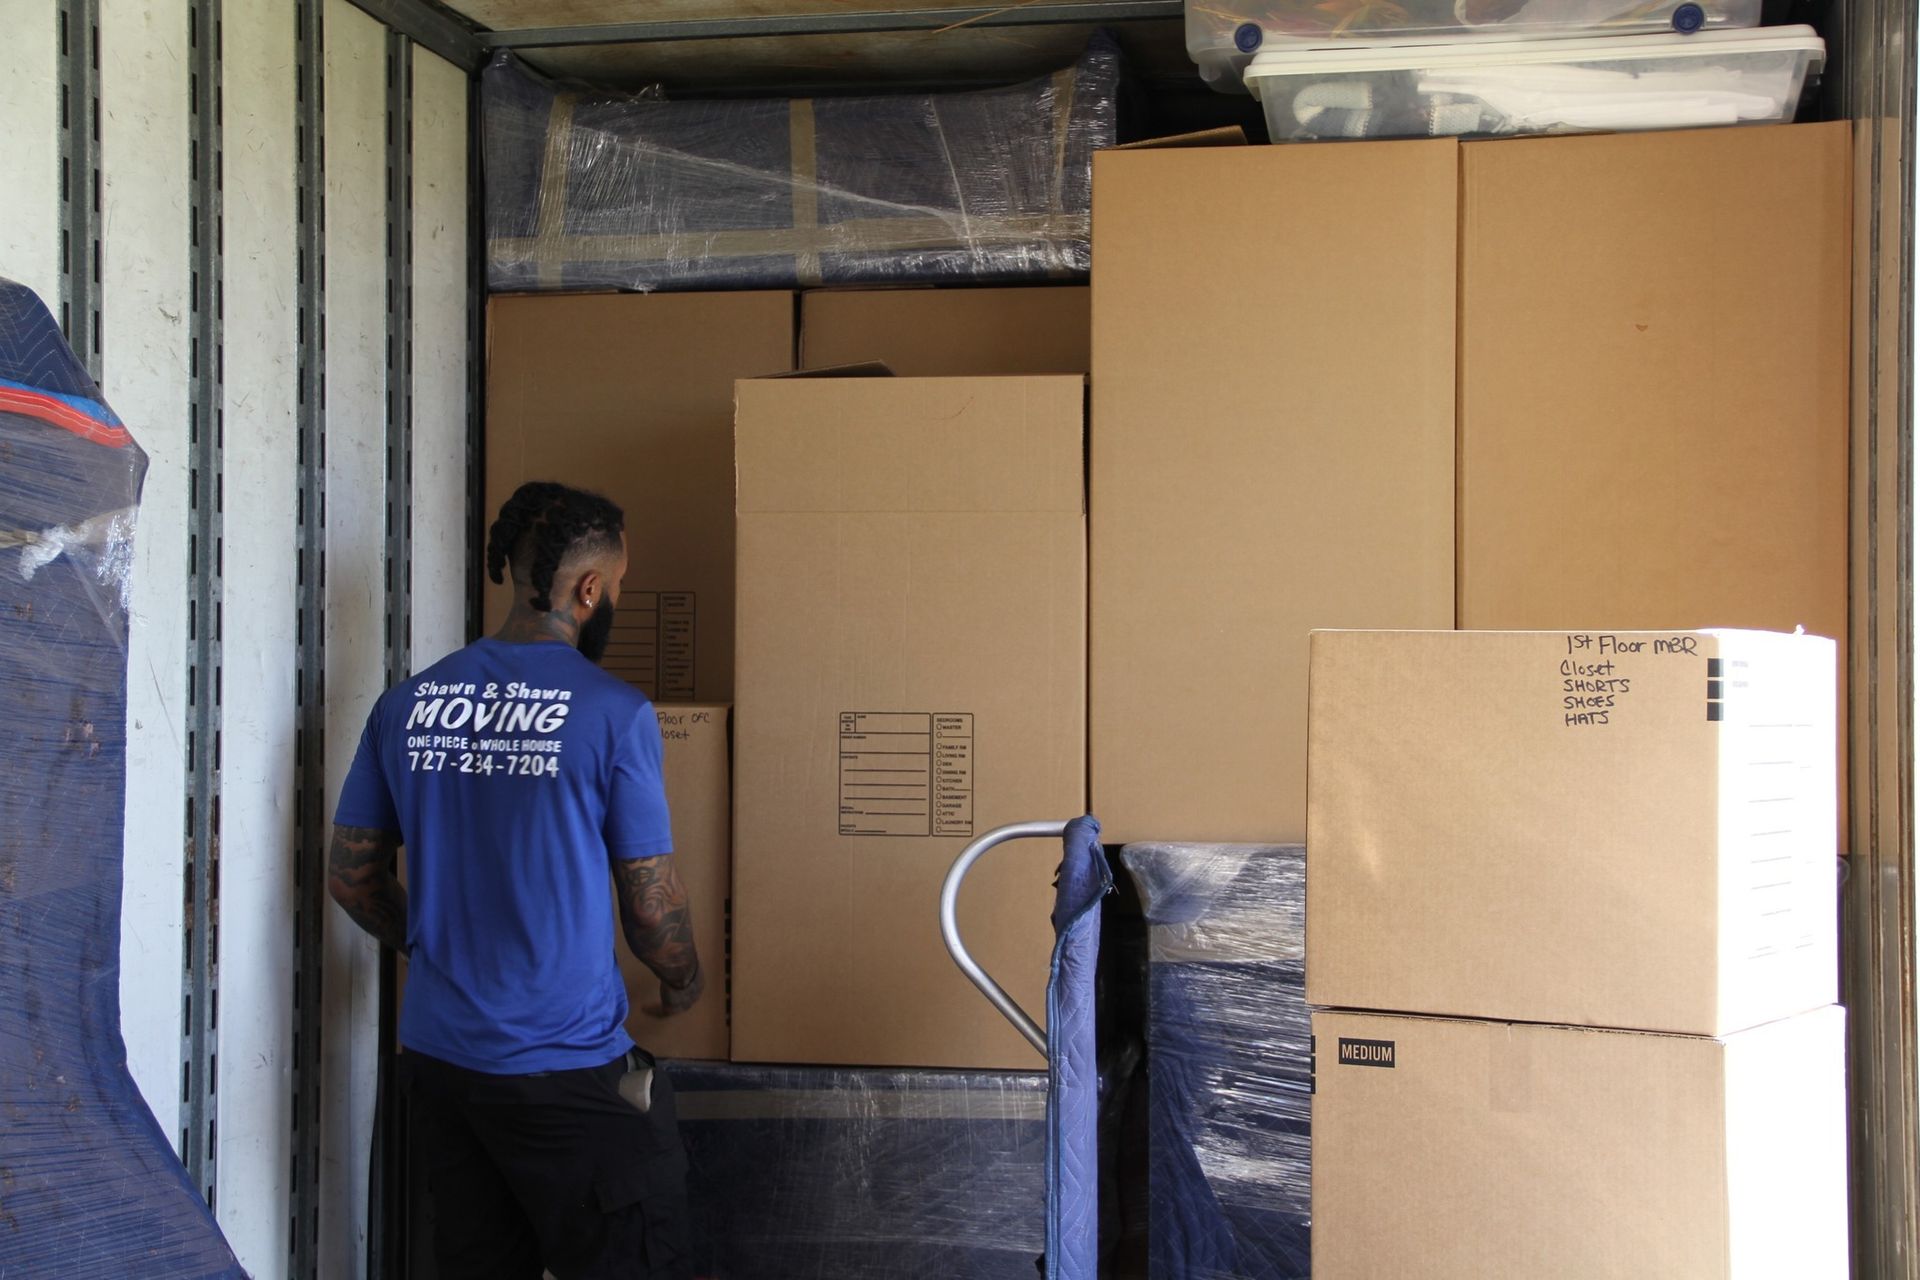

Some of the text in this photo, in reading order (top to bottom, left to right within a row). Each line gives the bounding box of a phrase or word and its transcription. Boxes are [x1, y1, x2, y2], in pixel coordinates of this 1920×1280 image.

[1567, 634, 1593, 655] 1st
[1598, 635, 1647, 655] Floor
[1560, 659, 1615, 677] Closet
[414, 681, 572, 701] Shawn & Shawn
[1563, 678, 1630, 693] SHORTS
[1563, 694, 1615, 709] SHOES
[405, 697, 569, 733] MOVING
[656, 711, 685, 725] Floor
[1565, 710, 1609, 727] HATS
[661, 727, 690, 740] loset
[407, 735, 431, 748] ONE
[433, 736, 468, 750] PIECE
[479, 739, 519, 752] WHOLE
[521, 740, 562, 753] HOUSE
[408, 750, 559, 778] 727-234-7204
[1341, 1043, 1393, 1062] MEDIUM
